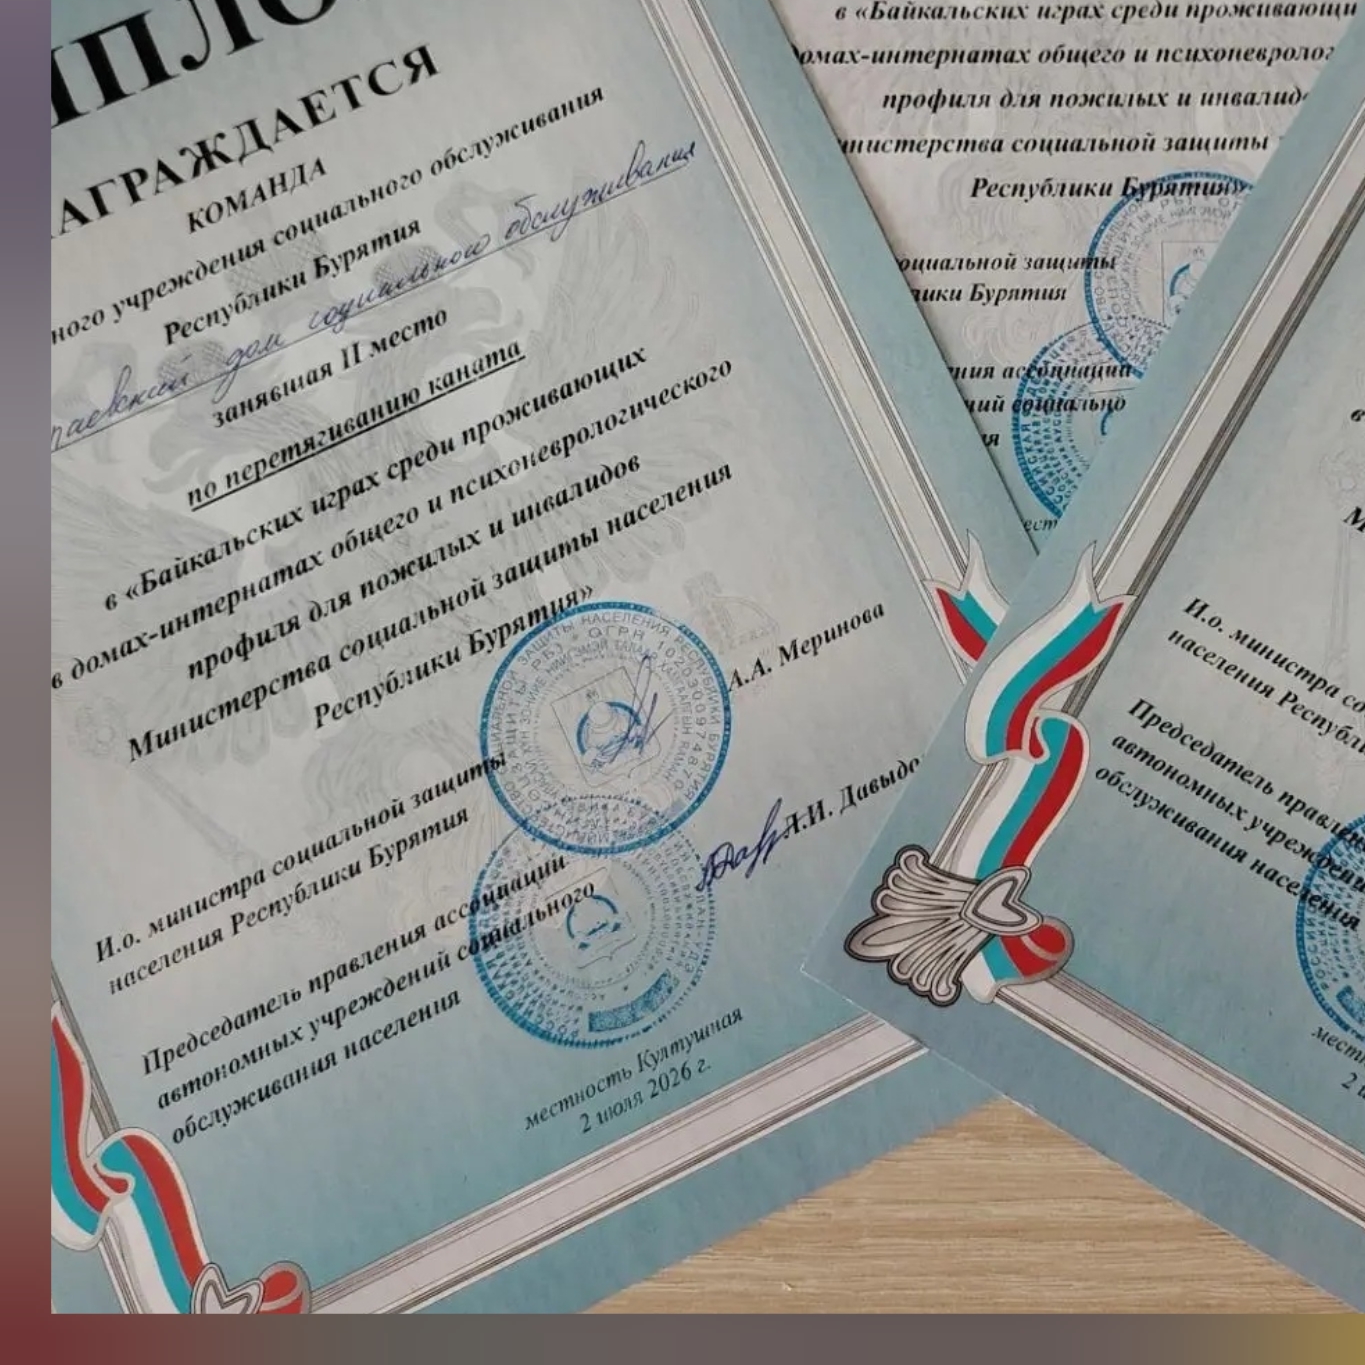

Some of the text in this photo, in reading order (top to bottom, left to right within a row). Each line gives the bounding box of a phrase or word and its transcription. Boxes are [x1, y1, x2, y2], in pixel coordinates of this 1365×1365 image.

[834, 6, 847, 21] в
[855, 0, 1029, 21] «Байкальских
[1036, 4, 1105, 26] играх
[1110, 0, 1179, 25] среди
[51, 45, 438, 238] АГРАЖДАЕТСЯ
[882, 87, 991, 115] профиля
[999, 89, 1042, 108] для
[1049, 92, 1169, 108] пожилых
[1177, 92, 1192, 108] и
[111, 86, 604, 324] учреждения социального обслуживания
[187, 157, 327, 234] КОМАНДА
[213, 332, 290, 385] дом
[187, 342, 521, 507] по перетягиванию каната
[51, 360, 732, 690] в домах-интернатах общего и психоневрологического
[128, 463, 732, 762] Министерства социальной защиты населения
[724, 603, 885, 699] А.А. Меринова
[1183, 597, 1223, 633] И.о.
[1228, 629, 1341, 699] министра
[525, 1007, 744, 1131] местность Култушная
[579, 1058, 712, 1135] 2 июля 2026 г.
